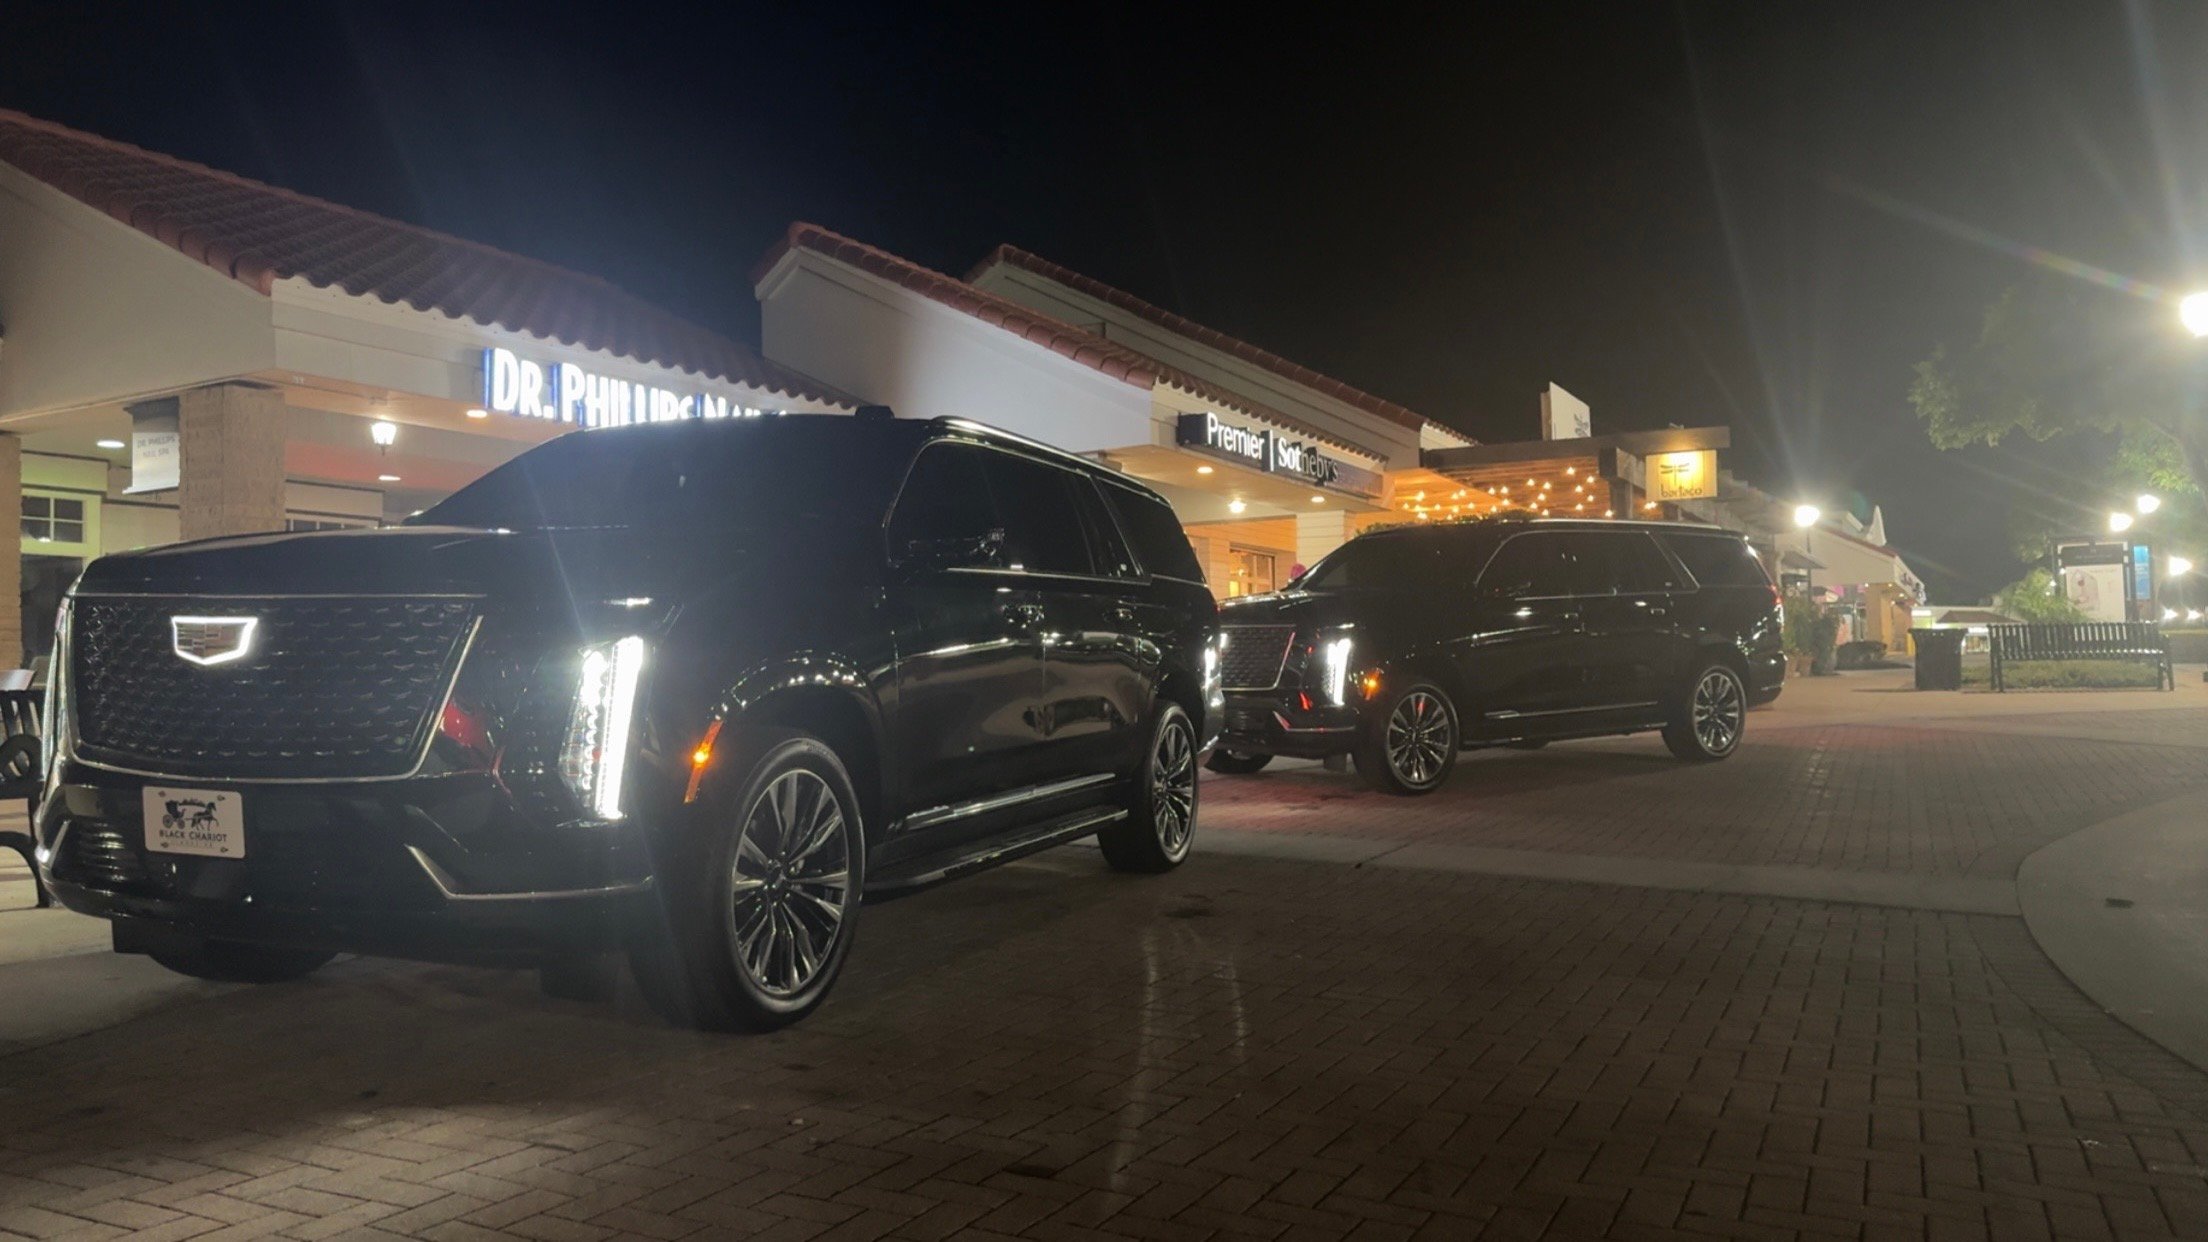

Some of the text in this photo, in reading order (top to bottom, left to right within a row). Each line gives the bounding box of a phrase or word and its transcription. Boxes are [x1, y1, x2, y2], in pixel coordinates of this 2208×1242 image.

[489, 346, 554, 420] DR.
[1206, 411, 1265, 460] Premier
[159, 829, 227, 842] BLACK CHARIOT
